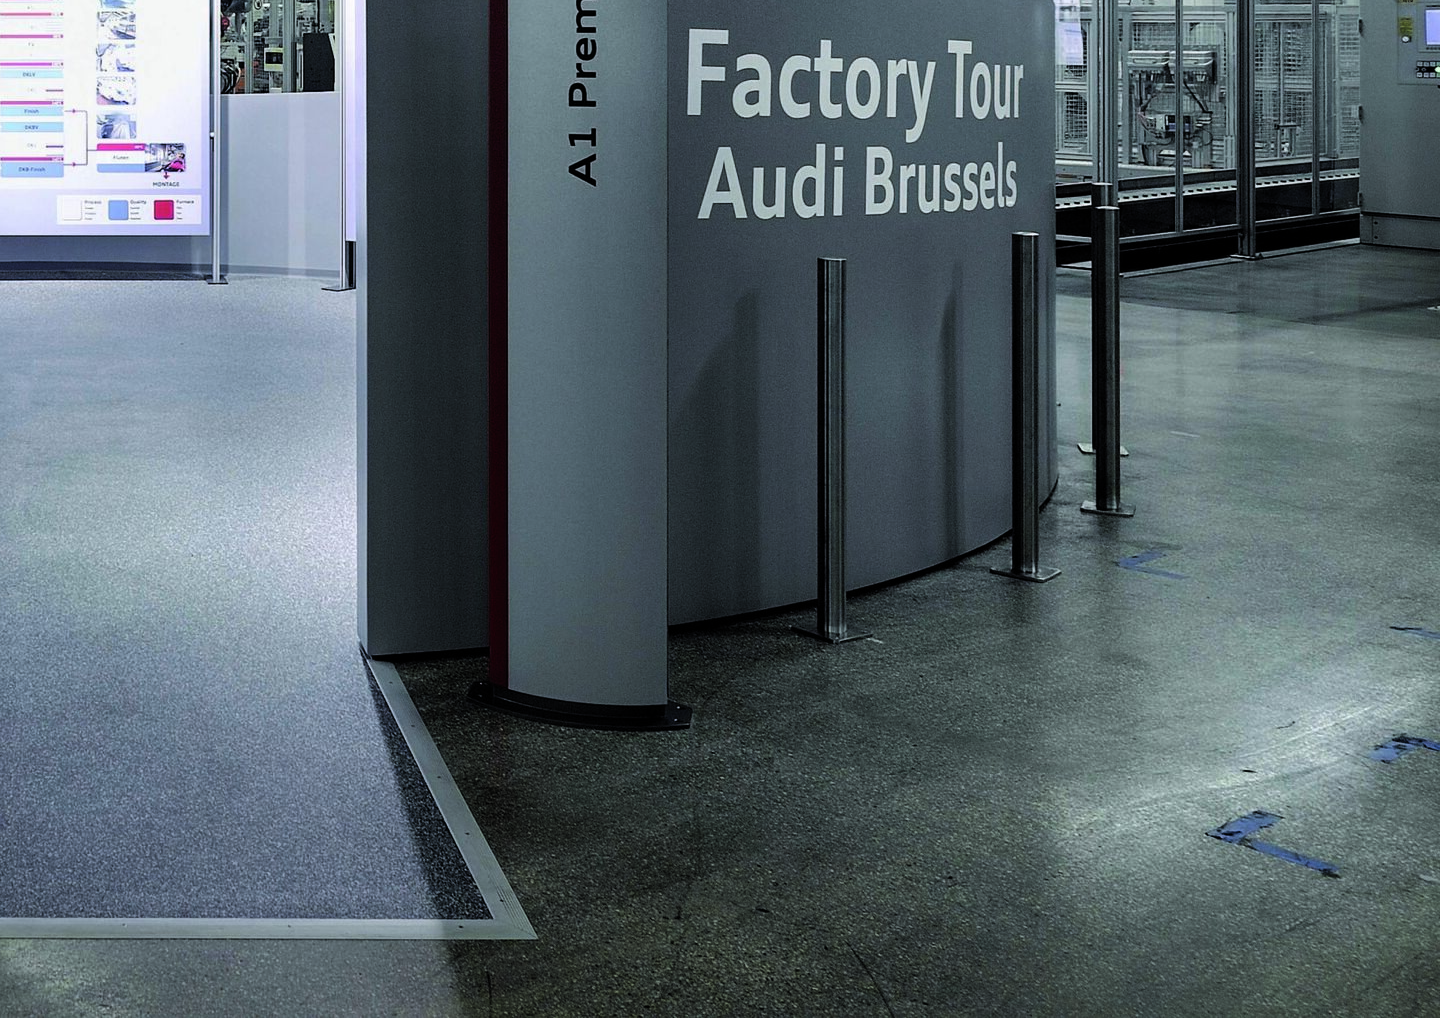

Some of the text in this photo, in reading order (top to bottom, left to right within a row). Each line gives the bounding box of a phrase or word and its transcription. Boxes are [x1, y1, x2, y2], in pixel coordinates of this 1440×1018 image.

[687, 28, 1024, 143] Factory Tour
[568, 127, 597, 187] A1
[697, 141, 1017, 220] Audi Brussels
